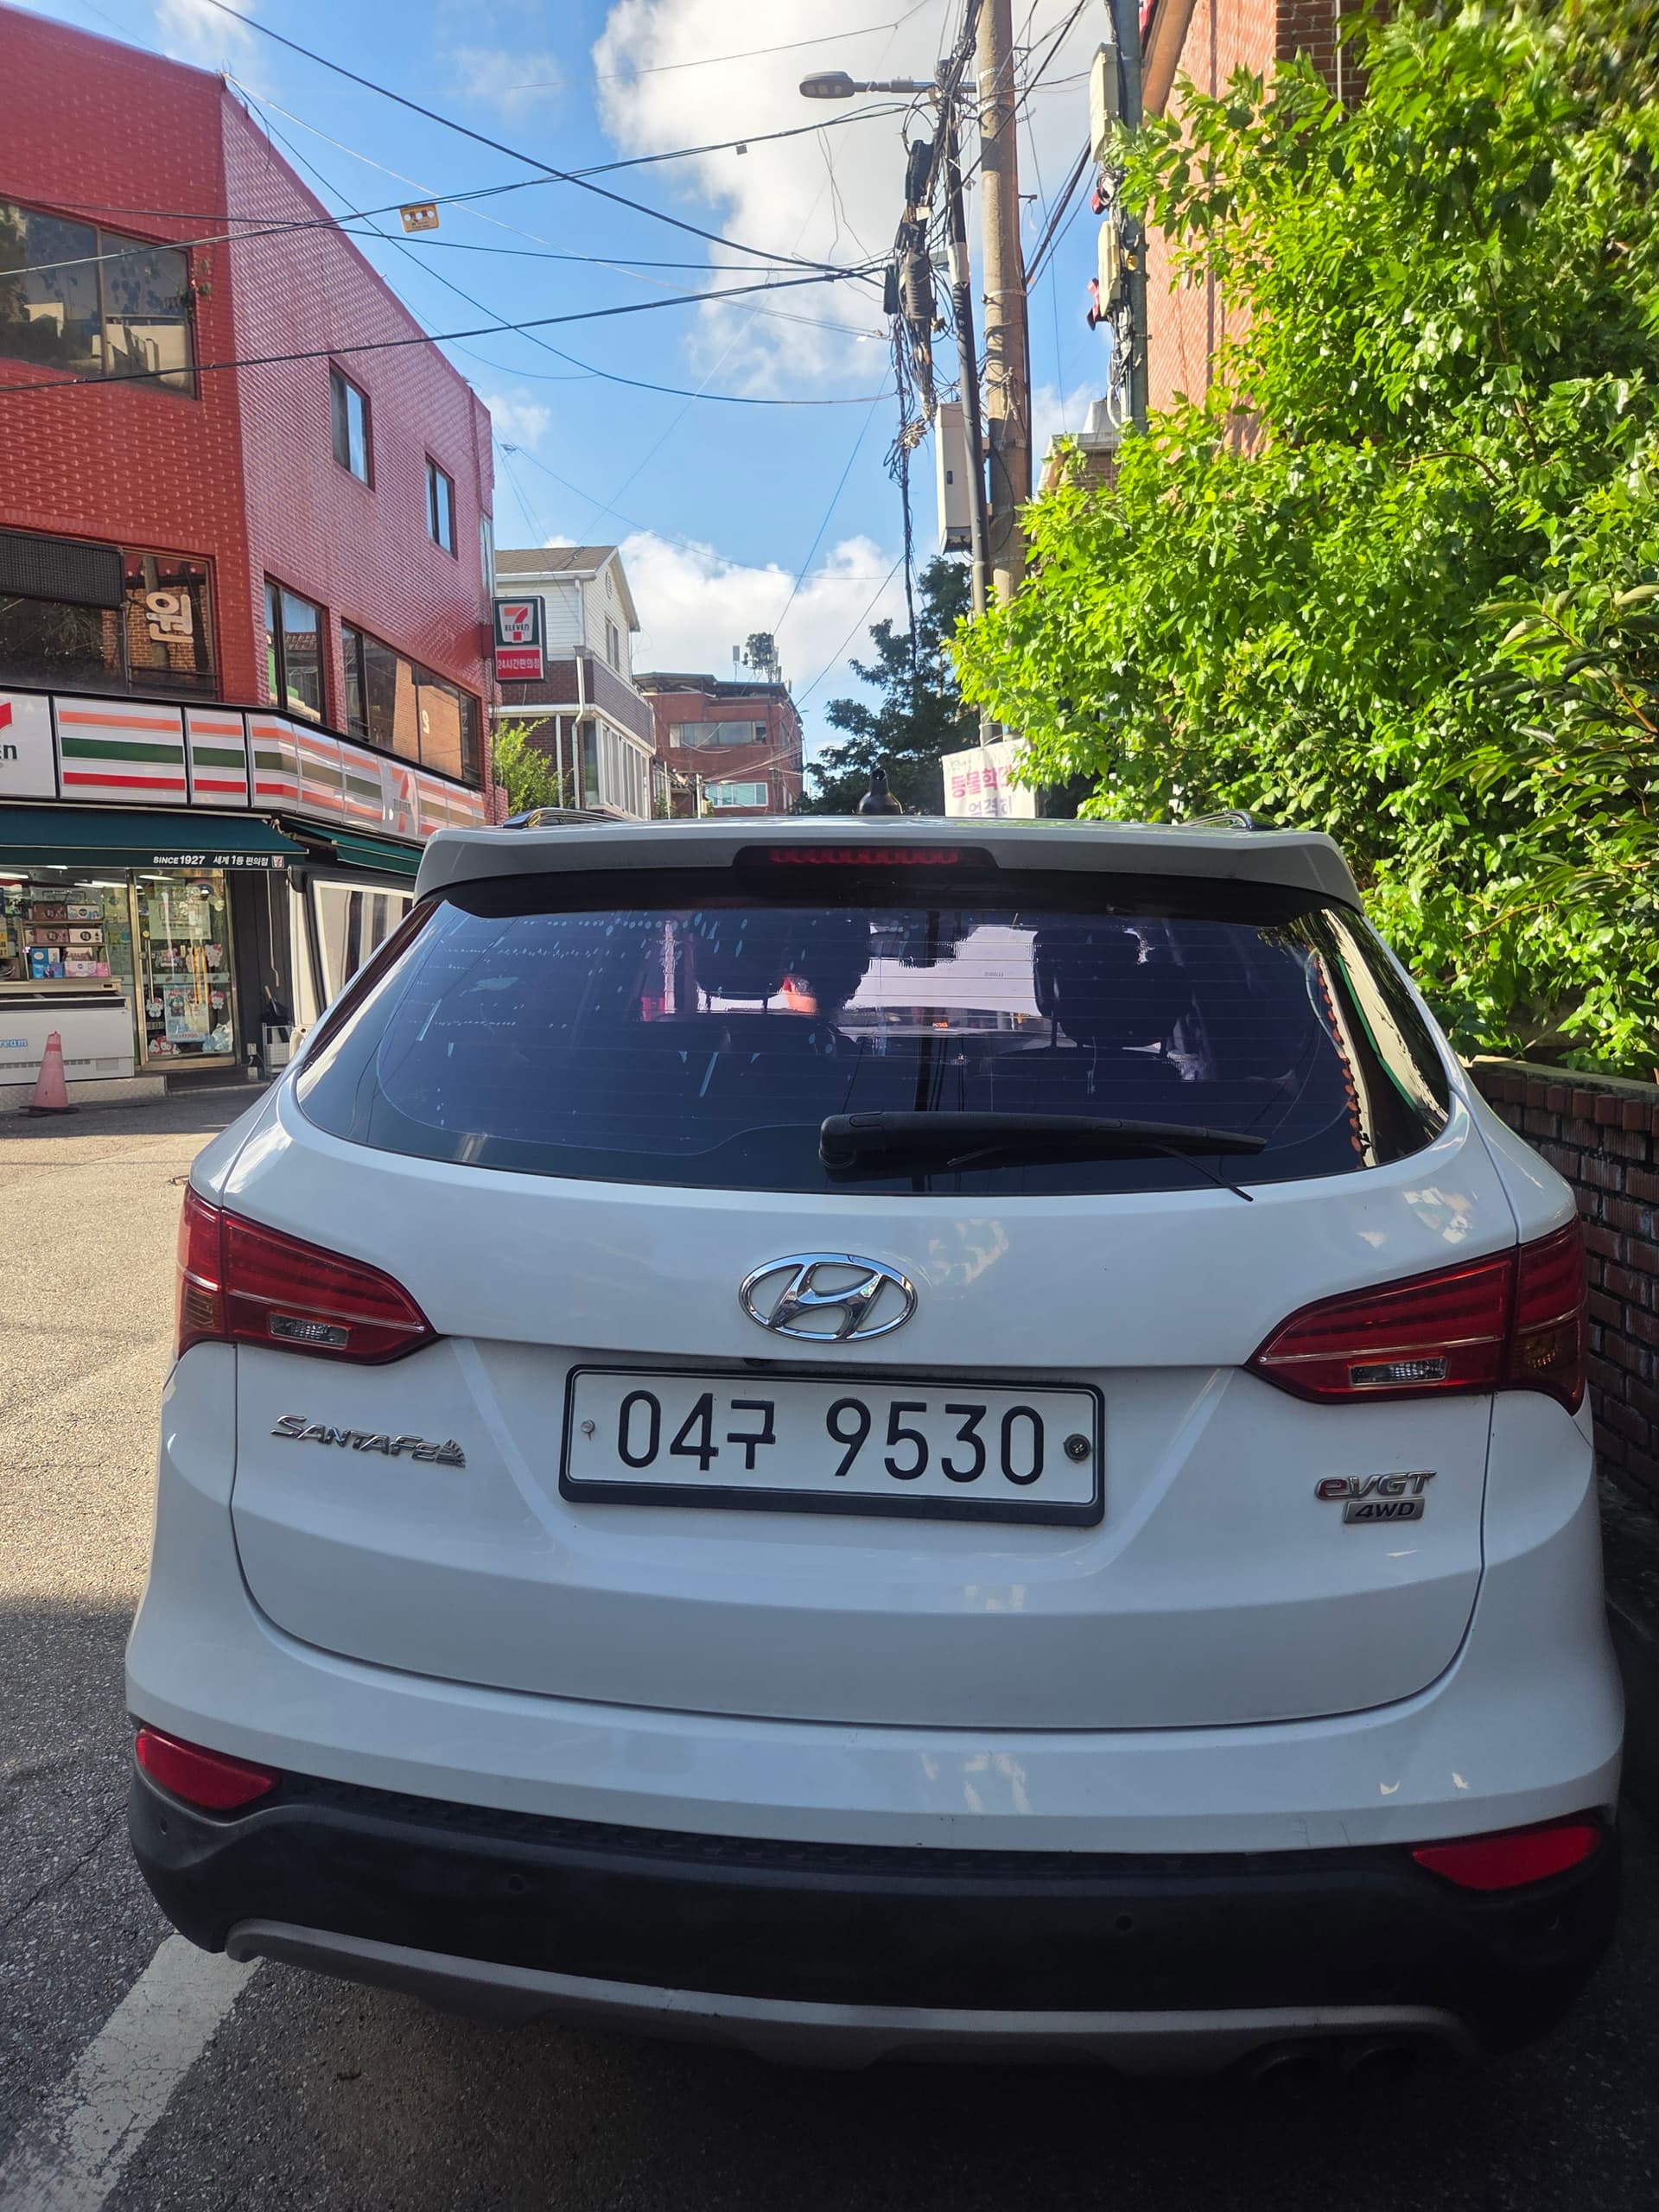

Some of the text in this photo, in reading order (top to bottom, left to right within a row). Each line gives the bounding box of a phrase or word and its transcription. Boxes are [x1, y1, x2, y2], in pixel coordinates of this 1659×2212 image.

[145, 592, 194, 644] 원
[504, 607, 528, 641] 7
[180, 855, 206, 865] 1927
[213, 855, 230, 865] 세계
[246, 856, 269, 867] 편의점
[617, 1389, 1045, 1485] 04구 9530
[1315, 1470, 1438, 1500] eVGT
[1354, 1502, 1415, 1519] 4WD
